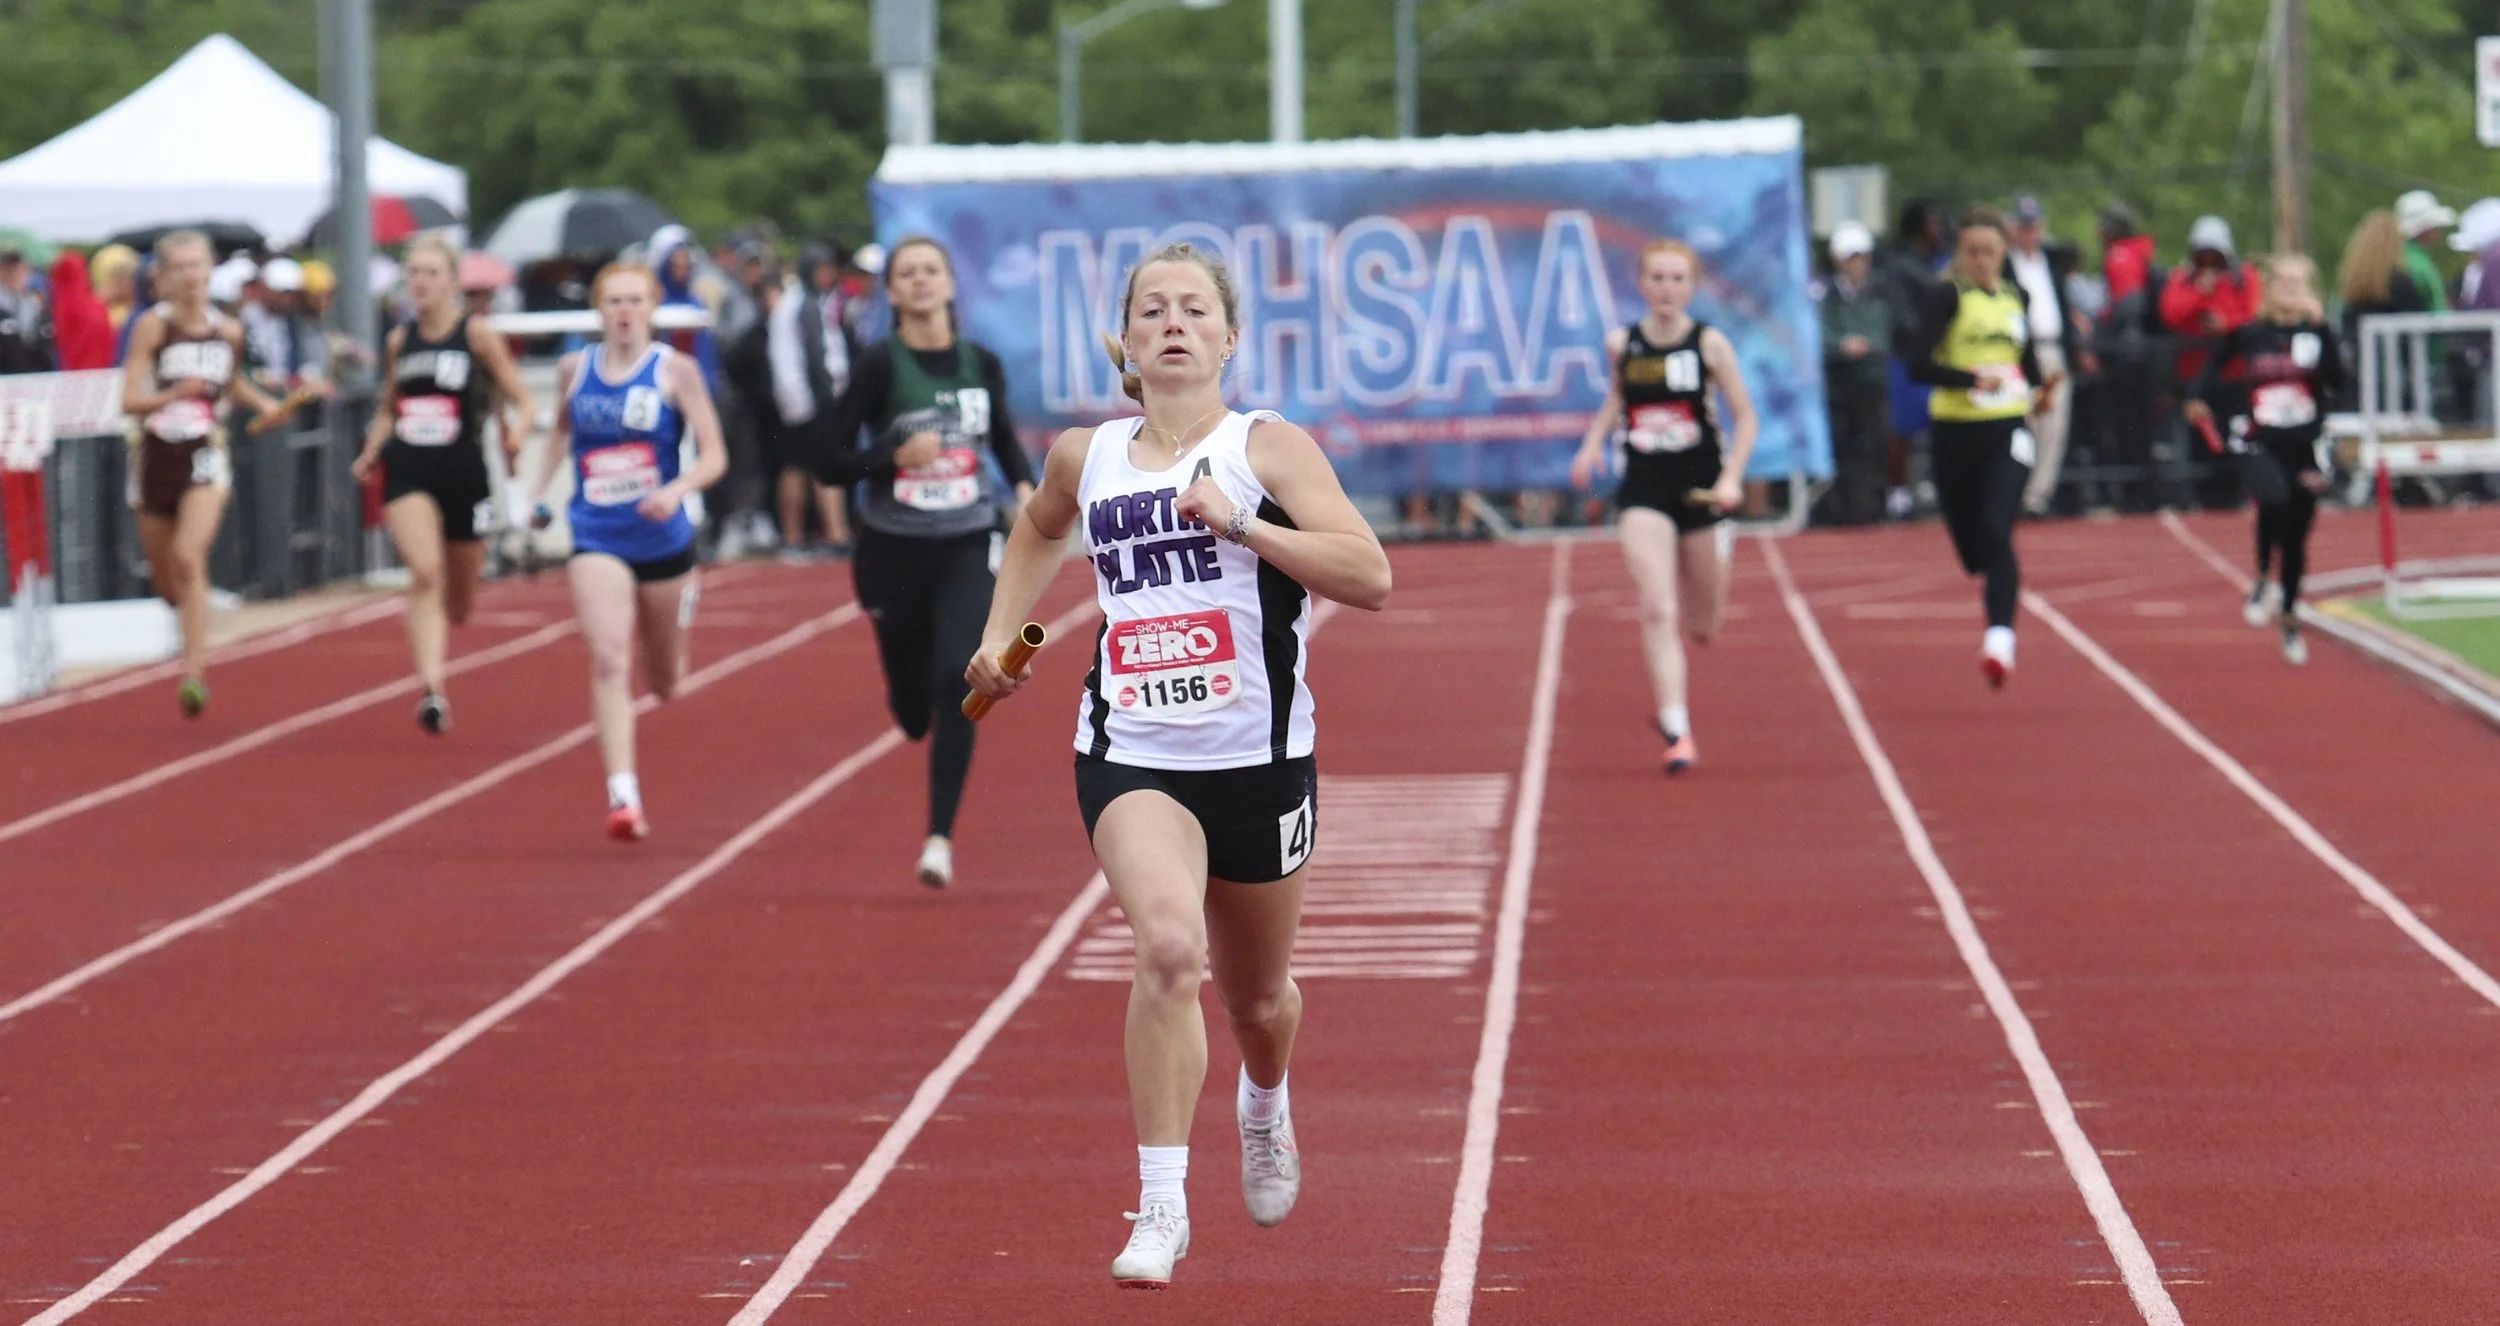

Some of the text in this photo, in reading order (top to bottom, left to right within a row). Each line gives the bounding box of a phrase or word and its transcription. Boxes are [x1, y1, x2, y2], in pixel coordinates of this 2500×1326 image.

[1039, 209, 1614, 412] MHSAA
[1096, 535, 1222, 597] PLATTE
[1117, 626, 1218, 666] ZERO
[1135, 618, 1190, 635] SHOW-ME
[1140, 675, 1208, 708] 1156
[1288, 807, 1308, 859] 4
